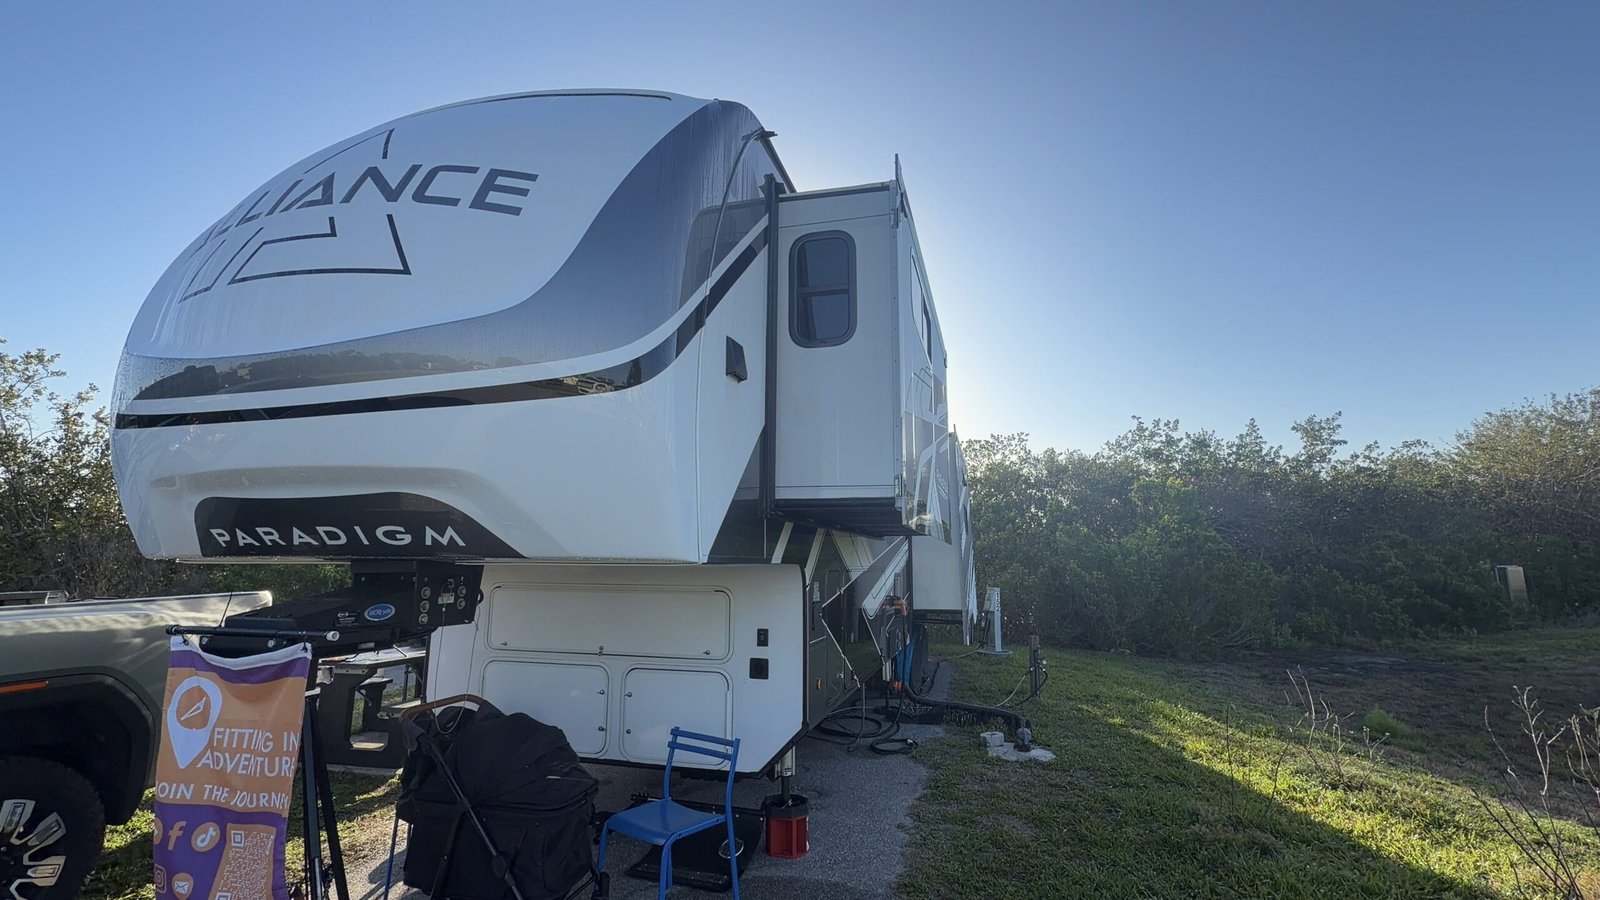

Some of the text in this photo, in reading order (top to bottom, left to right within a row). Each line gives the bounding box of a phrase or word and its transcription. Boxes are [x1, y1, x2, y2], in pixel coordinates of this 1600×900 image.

[209, 525, 466, 547] PARADIGM
[213, 727, 300, 752] FITTING IN
[203, 784, 230, 803] THE
